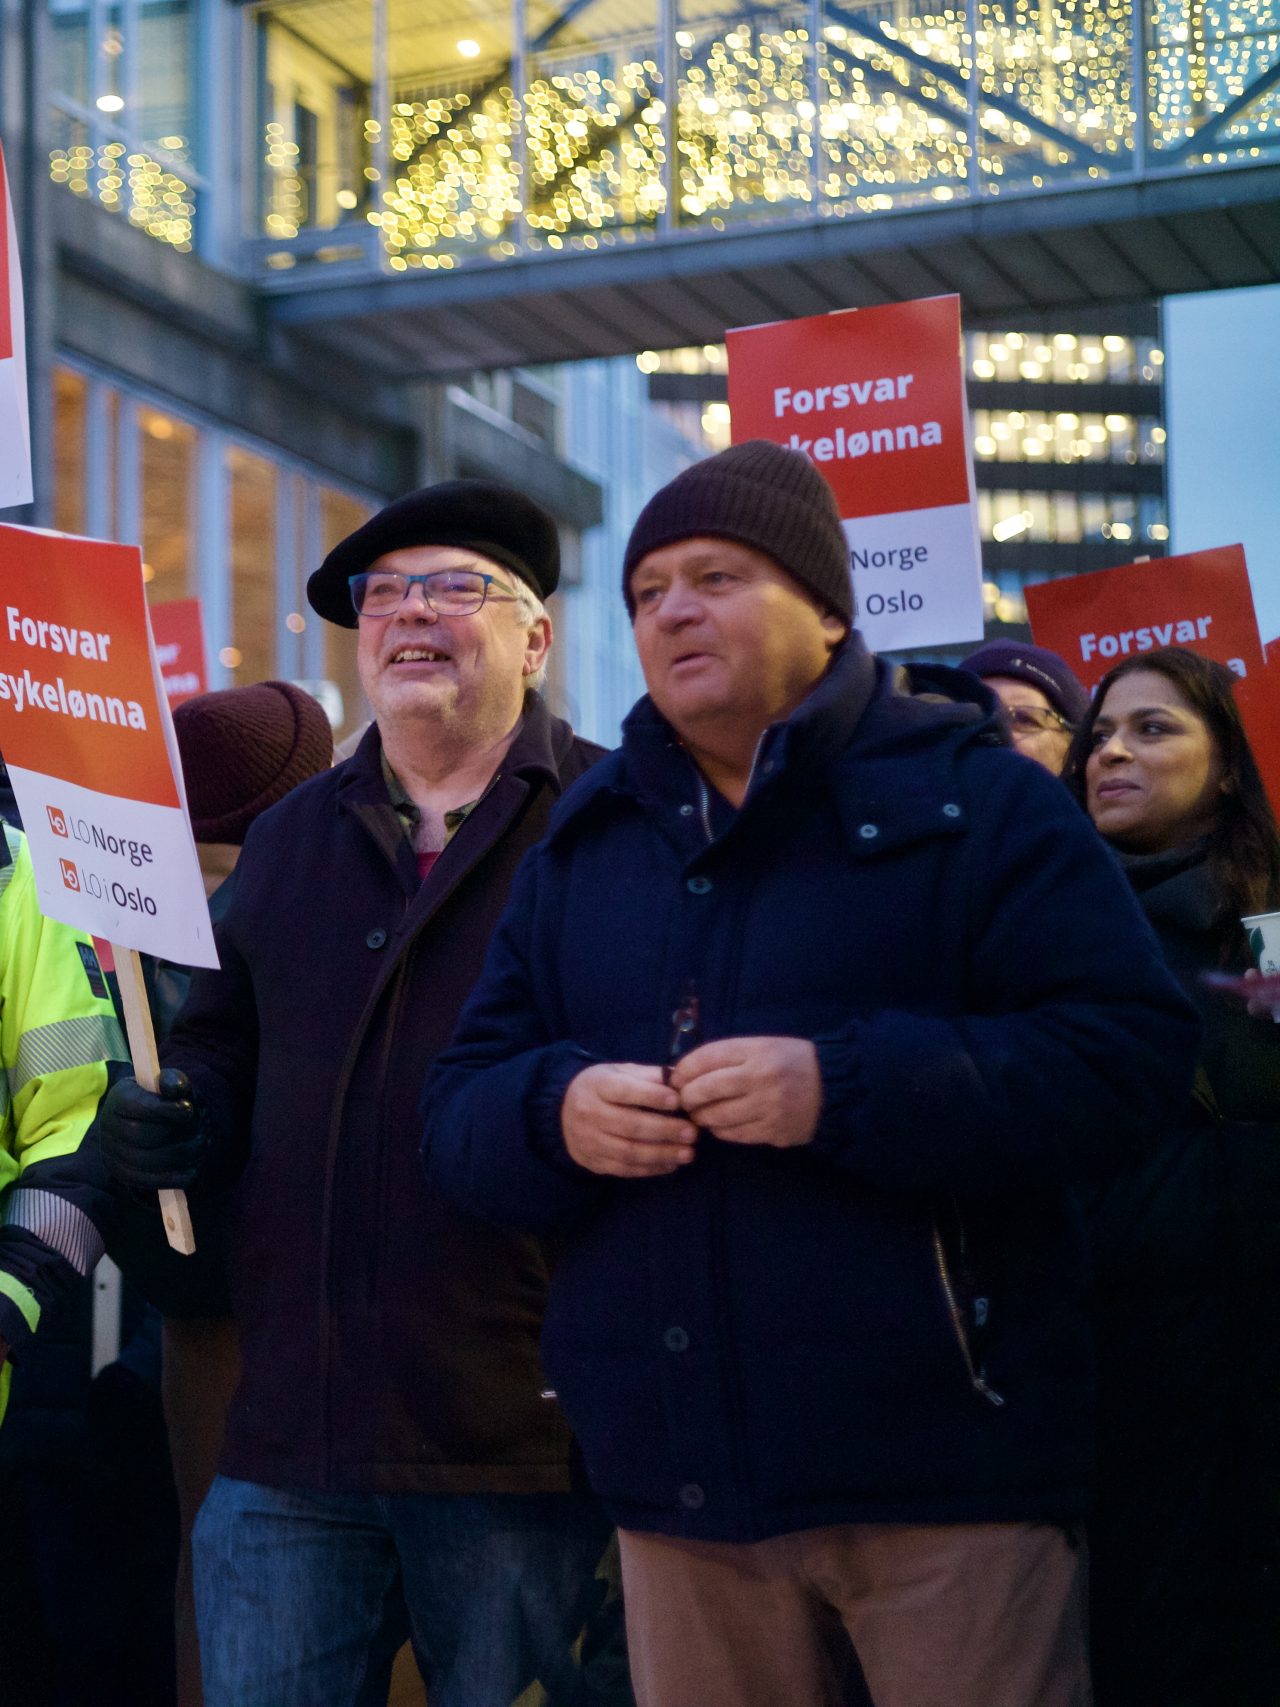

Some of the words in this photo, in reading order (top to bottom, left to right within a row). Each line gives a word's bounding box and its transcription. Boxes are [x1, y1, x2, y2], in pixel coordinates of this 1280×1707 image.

[773, 373, 914, 417] Forsvar
[850, 545, 928, 571] Norge
[866, 589, 923, 616] Oslo
[6, 606, 111, 662] Forsvar
[1079, 615, 1213, 662] Forsvar
[91, 825, 153, 867] Norge
[111, 882, 157, 916] Oslo
